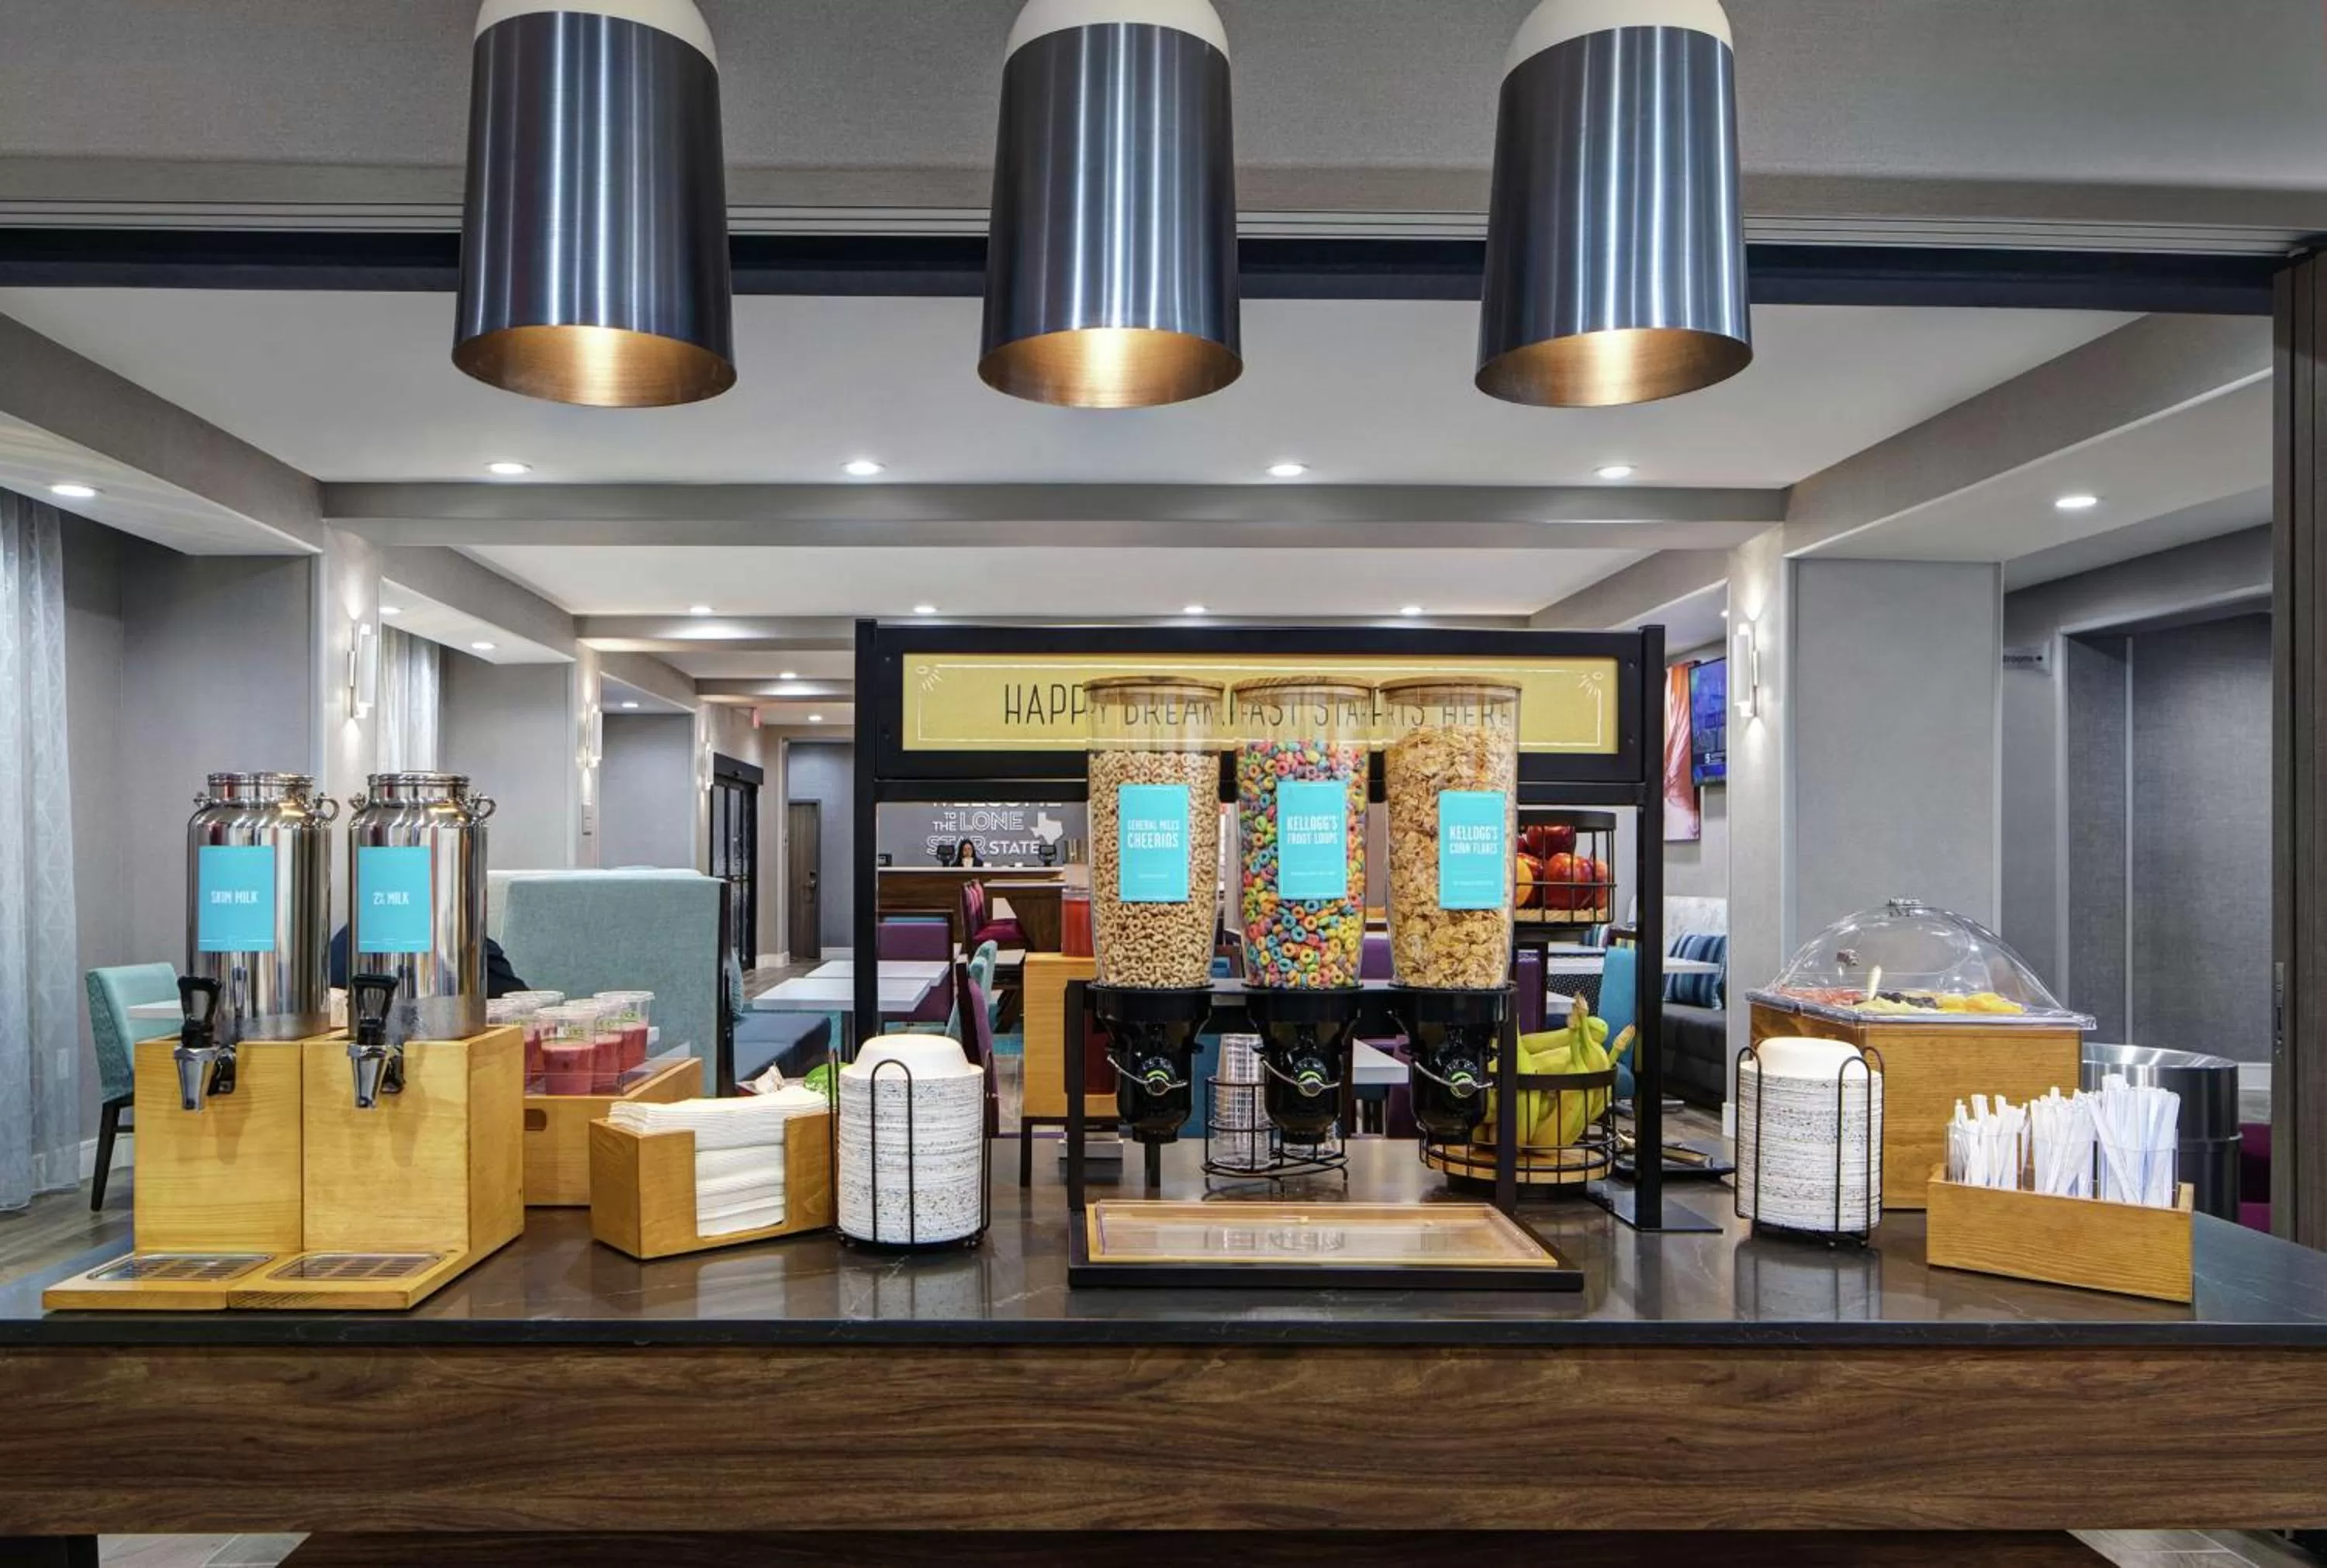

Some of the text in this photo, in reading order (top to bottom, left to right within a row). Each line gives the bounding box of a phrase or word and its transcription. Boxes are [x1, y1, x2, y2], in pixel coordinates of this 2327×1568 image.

[1004, 683, 1108, 726] HAPPY
[932, 810, 1025, 832] THE LONE
[1287, 815, 1338, 831] KELLOGG'S
[1127, 831, 1179, 849] CHEERIOS
[1449, 824, 1499, 841] KELLOGG'S
[989, 840, 1040, 855] STATE
[235, 889, 261, 904] MILK
[387, 892, 410, 905] MILK
